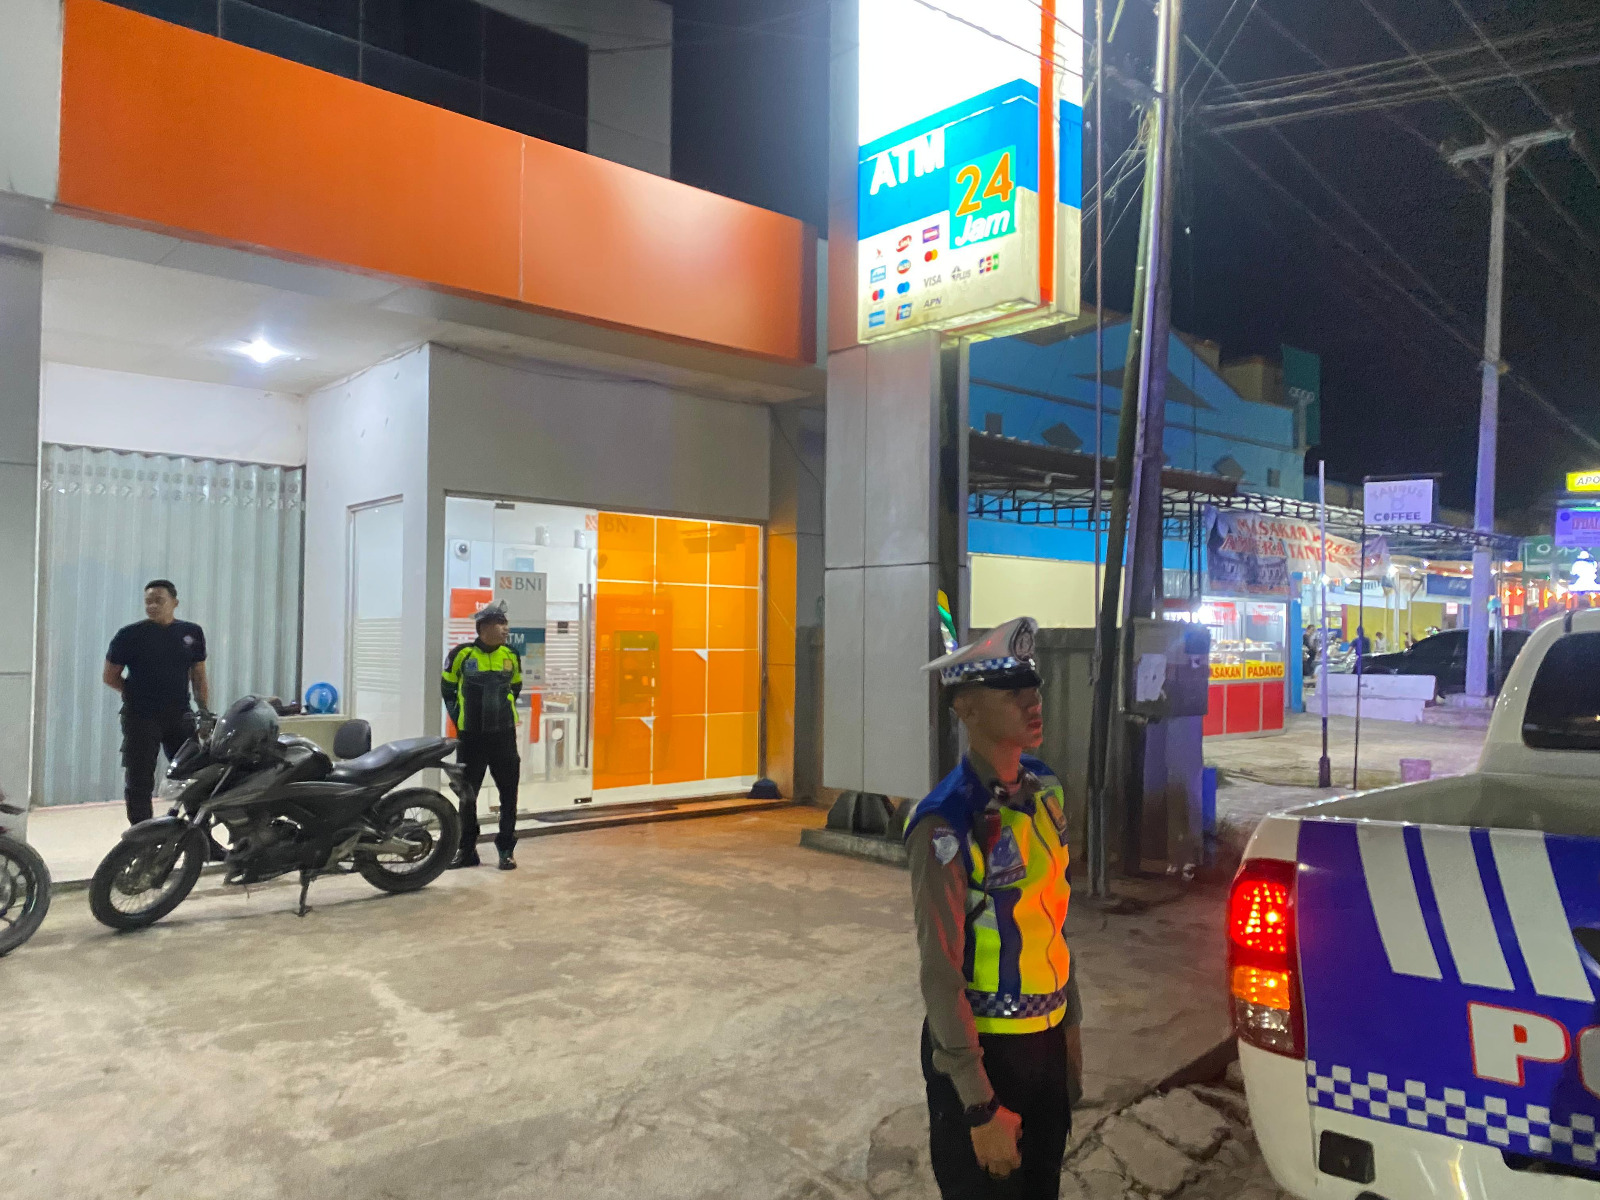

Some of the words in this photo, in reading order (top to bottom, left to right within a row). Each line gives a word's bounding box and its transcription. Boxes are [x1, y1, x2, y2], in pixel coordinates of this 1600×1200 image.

[869, 128, 945, 196] ATM
[955, 152, 1014, 217] 24
[954, 209, 1011, 247] Jam
[923, 274, 942, 288] VISA
[1374, 511, 1421, 522] COFFEE
[1237, 518, 1307, 541] MASAKAN
[515, 577, 542, 591] BNI
[1209, 666, 1241, 679] ASAKAN
[1247, 665, 1284, 677] PADANG
[1467, 1000, 1600, 1104] P
